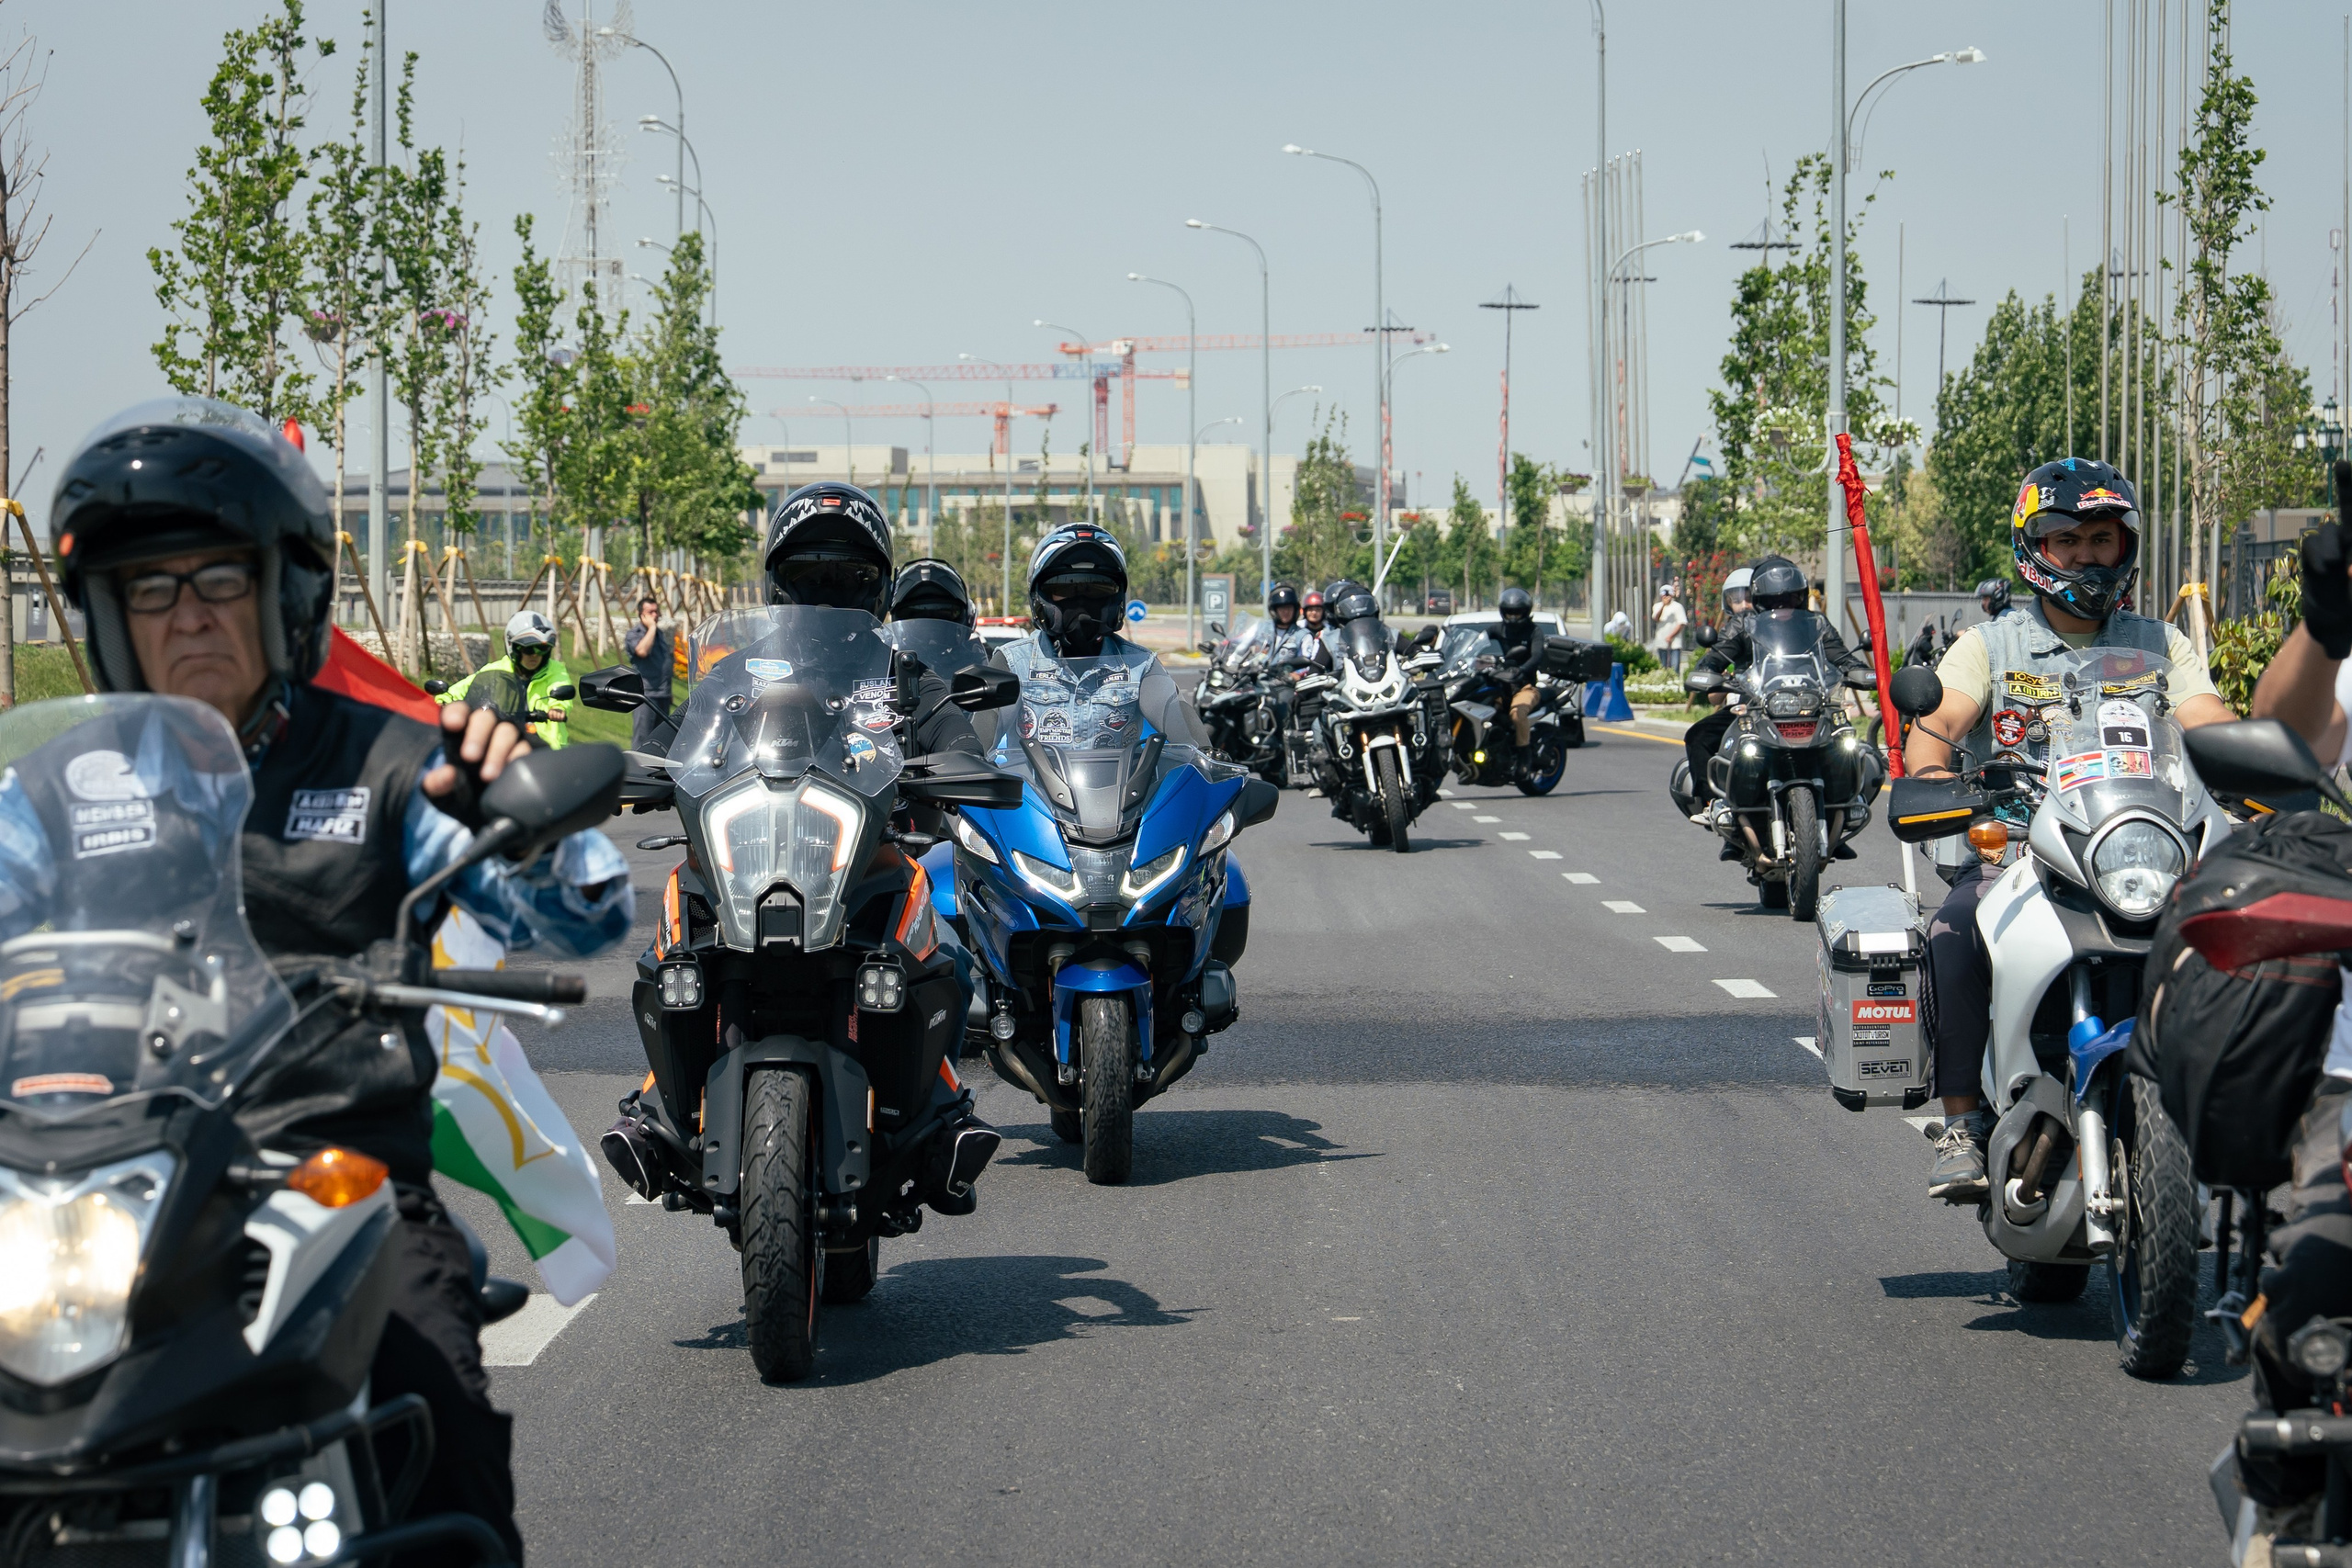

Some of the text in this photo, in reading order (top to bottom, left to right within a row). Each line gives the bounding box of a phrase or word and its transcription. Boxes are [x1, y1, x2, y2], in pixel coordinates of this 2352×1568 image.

[2028, 568, 2053, 592] Bull
[859, 691, 891, 700] VENOM
[770, 738, 799, 748] KTM
[2118, 731, 2133, 743] 16
[1857, 1006, 1912, 1019] MOTUL
[1860, 1060, 1909, 1075] SEVEN
